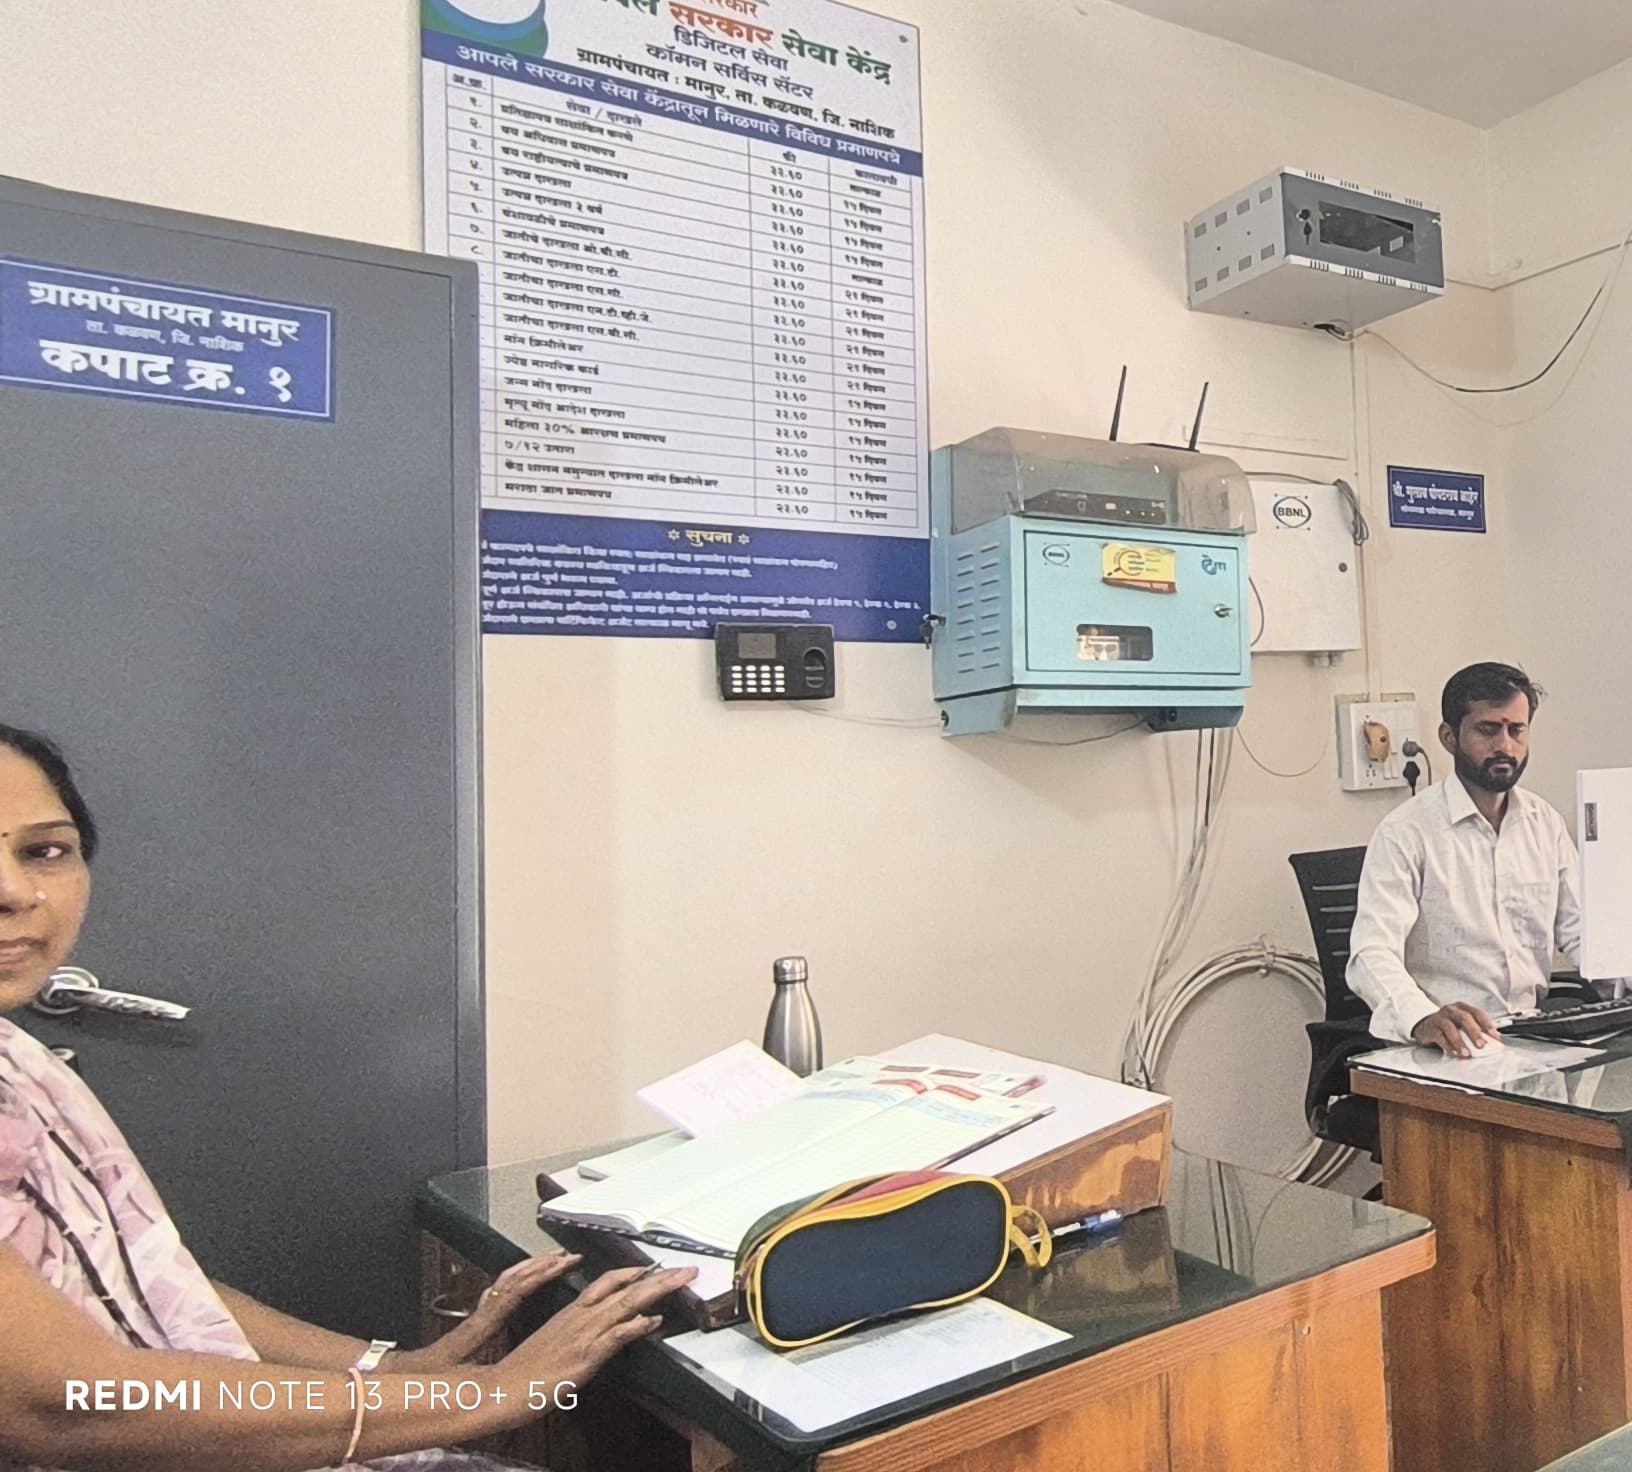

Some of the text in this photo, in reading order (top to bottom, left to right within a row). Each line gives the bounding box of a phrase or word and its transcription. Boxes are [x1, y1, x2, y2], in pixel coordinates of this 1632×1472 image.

[647, 43, 707, 72] कॉमन
[714, 59, 768, 88] सर्विस
[671, 3, 774, 49] सरकार
[782, 29, 839, 66] सेवा
[846, 46, 892, 85] केंद्र
[674, 25, 788, 71] डिजिटल सेवा
[457, 45, 901, 165] आपले सरकार सेवा केंद्रातून मिळणारे विविध प्रमाणपत्रे
[577, 47, 670, 84] ग्रामपंचायत
[685, 76, 731, 101] मानुर,
[735, 89, 758, 106] ता.
[762, 96, 819, 122] कळवण,
[823, 109, 846, 128] जि.
[849, 117, 896, 140] नाशिक
[28, 280, 300, 347] ग्रामपंचायत मानुर
[86, 319, 108, 335] ता.
[171, 331, 195, 347] जि.
[199, 335, 245, 352] नाशिक
[39, 339, 293, 403] कपाट क्र. १
[1277, 506, 1307, 519] BBNL
